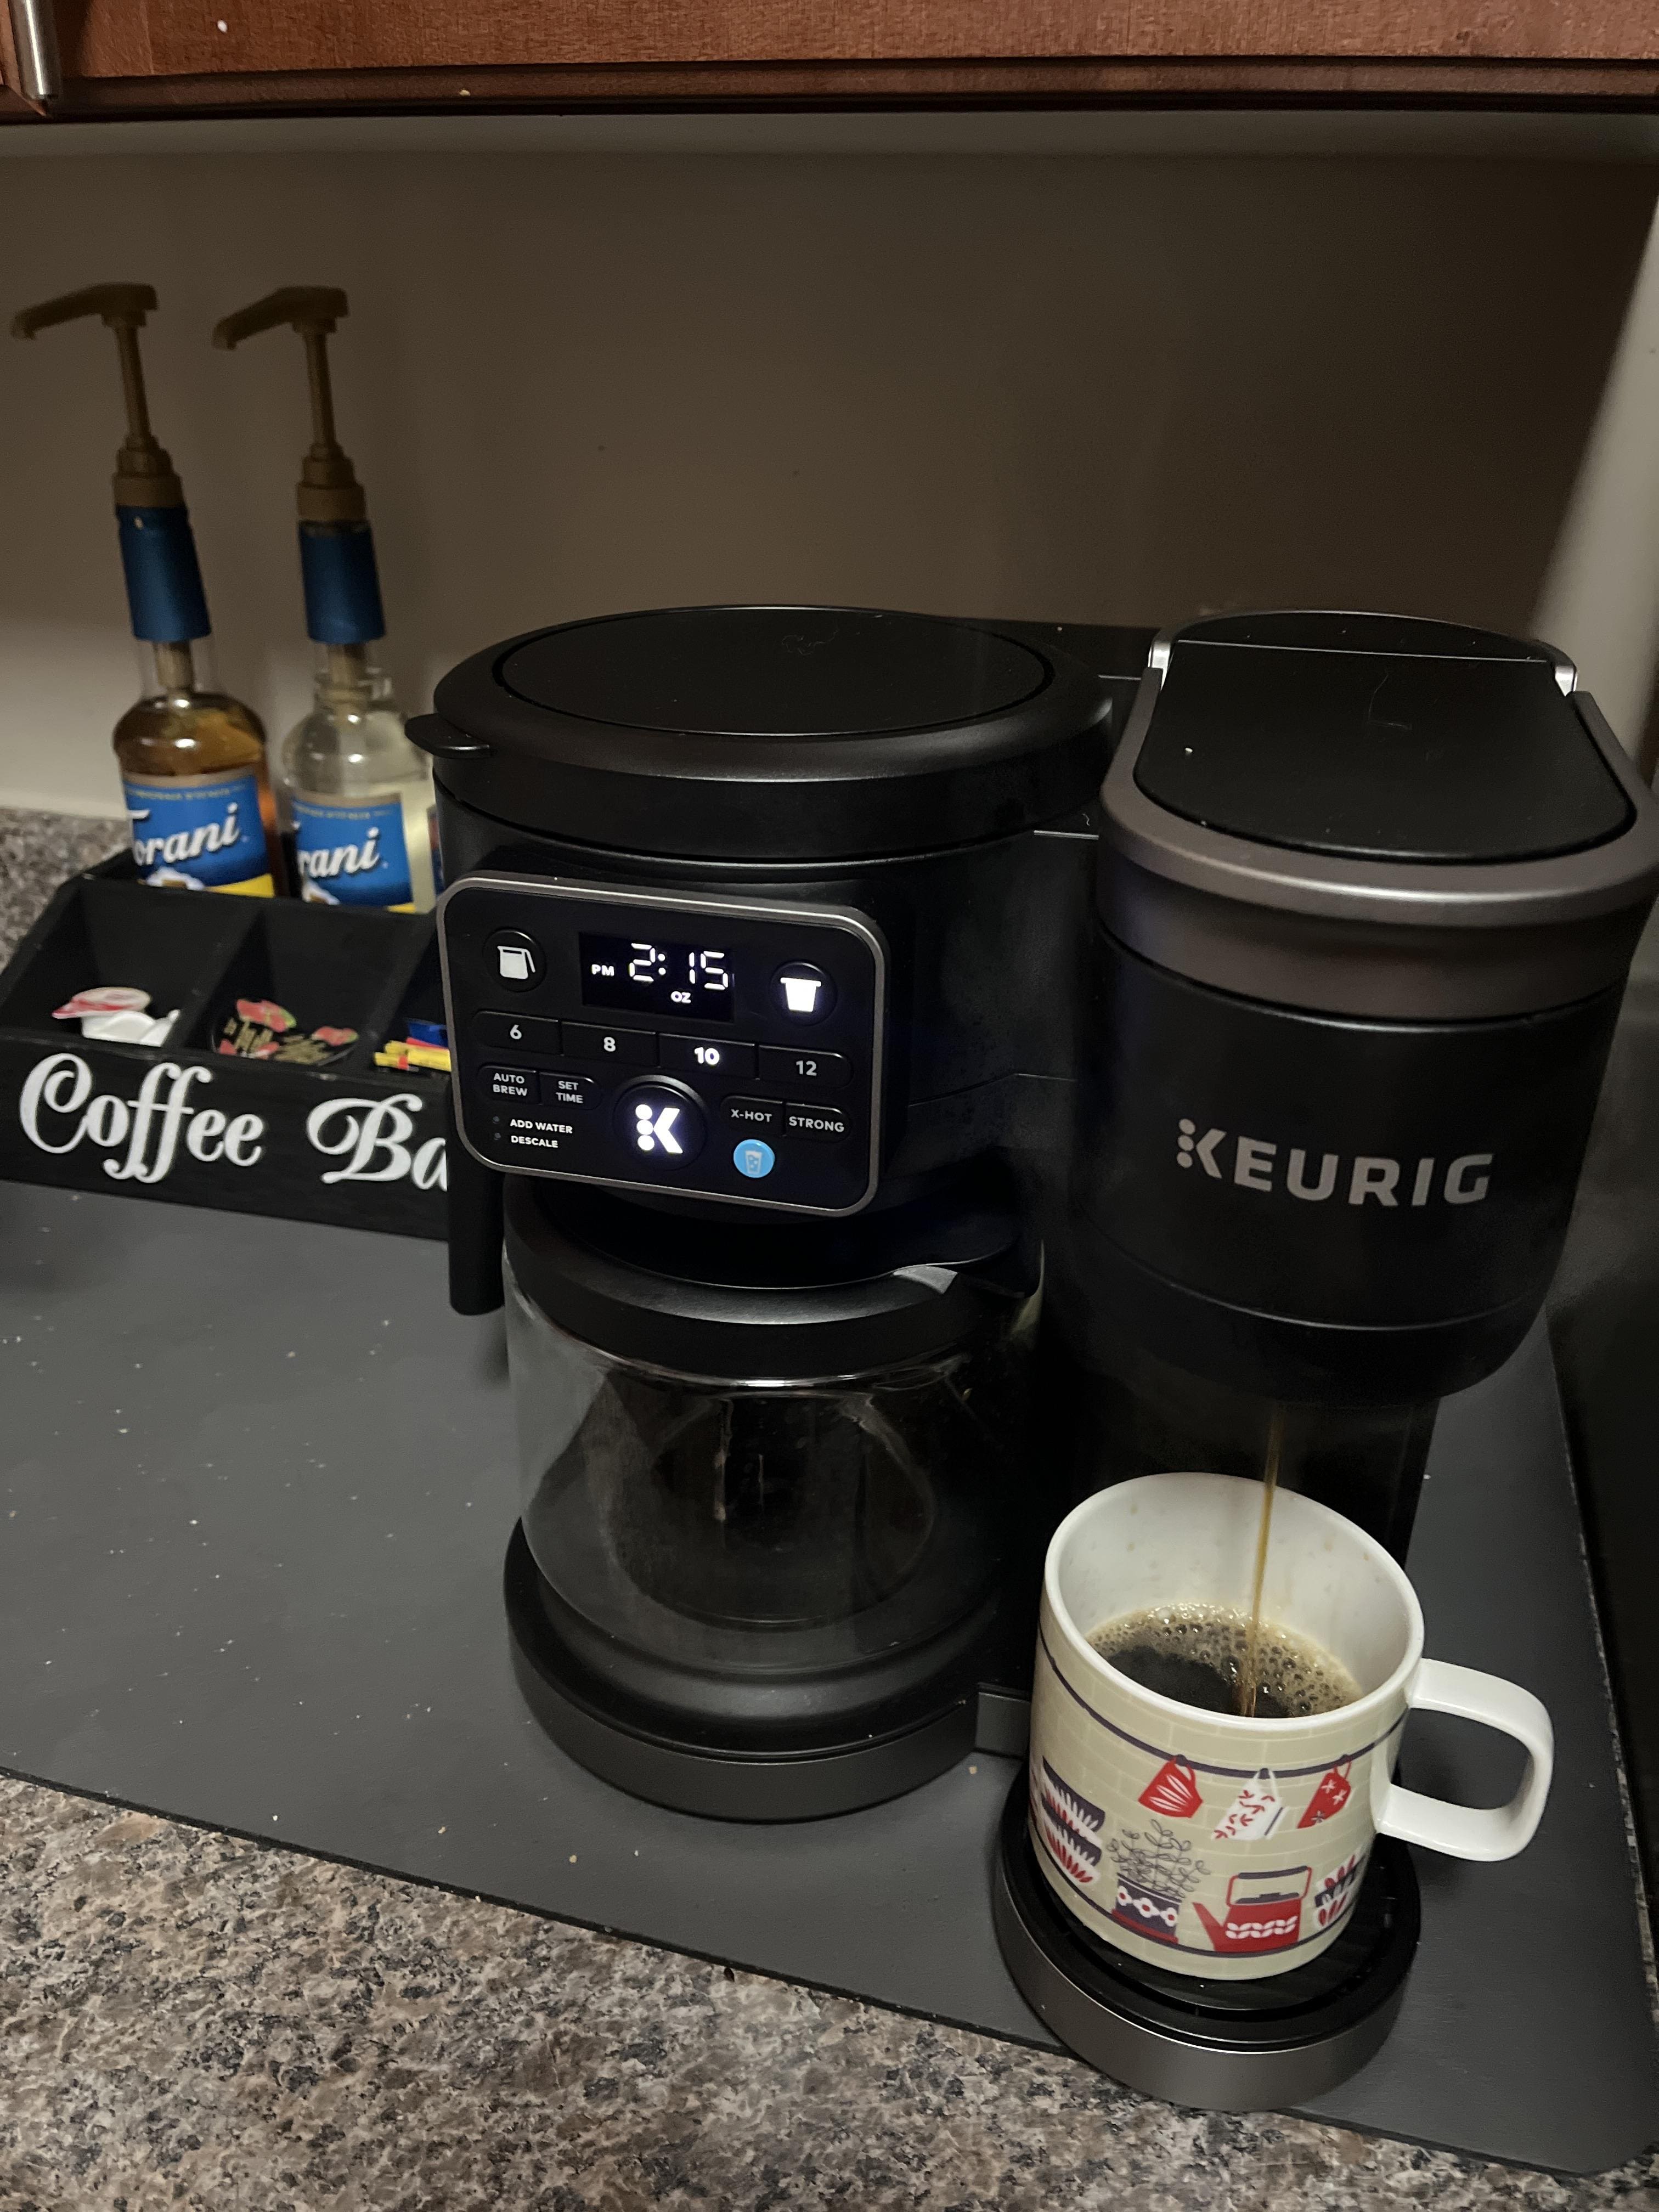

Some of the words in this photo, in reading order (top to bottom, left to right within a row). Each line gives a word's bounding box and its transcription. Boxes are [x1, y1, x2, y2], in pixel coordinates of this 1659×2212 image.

[126, 802, 240, 866] orani
[294, 826, 380, 878] rani
[591, 964, 615, 977] PM
[629, 943, 729, 990] 2:15
[670, 991, 691, 1003] OZ
[510, 1024, 522, 1040] 6
[603, 1036, 616, 1052] 8
[694, 1047, 720, 1065] 10
[796, 1060, 817, 1077] 12
[493, 1073, 525, 1084] AUTO
[558, 1080, 579, 1091] SET
[493, 1084, 528, 1097] BREW
[555, 1092, 584, 1104] TIME
[19, 1053, 267, 1183] Coffee
[306, 1093, 448, 1192] Ba
[731, 1109, 772, 1122] X-HOT
[510, 1119, 533, 1129] ADD
[534, 1122, 573, 1134] WATER
[788, 1116, 845, 1133] STRONG
[511, 1135, 559, 1148] DESCALE
[1176, 1118, 1493, 1207] KEURIG
